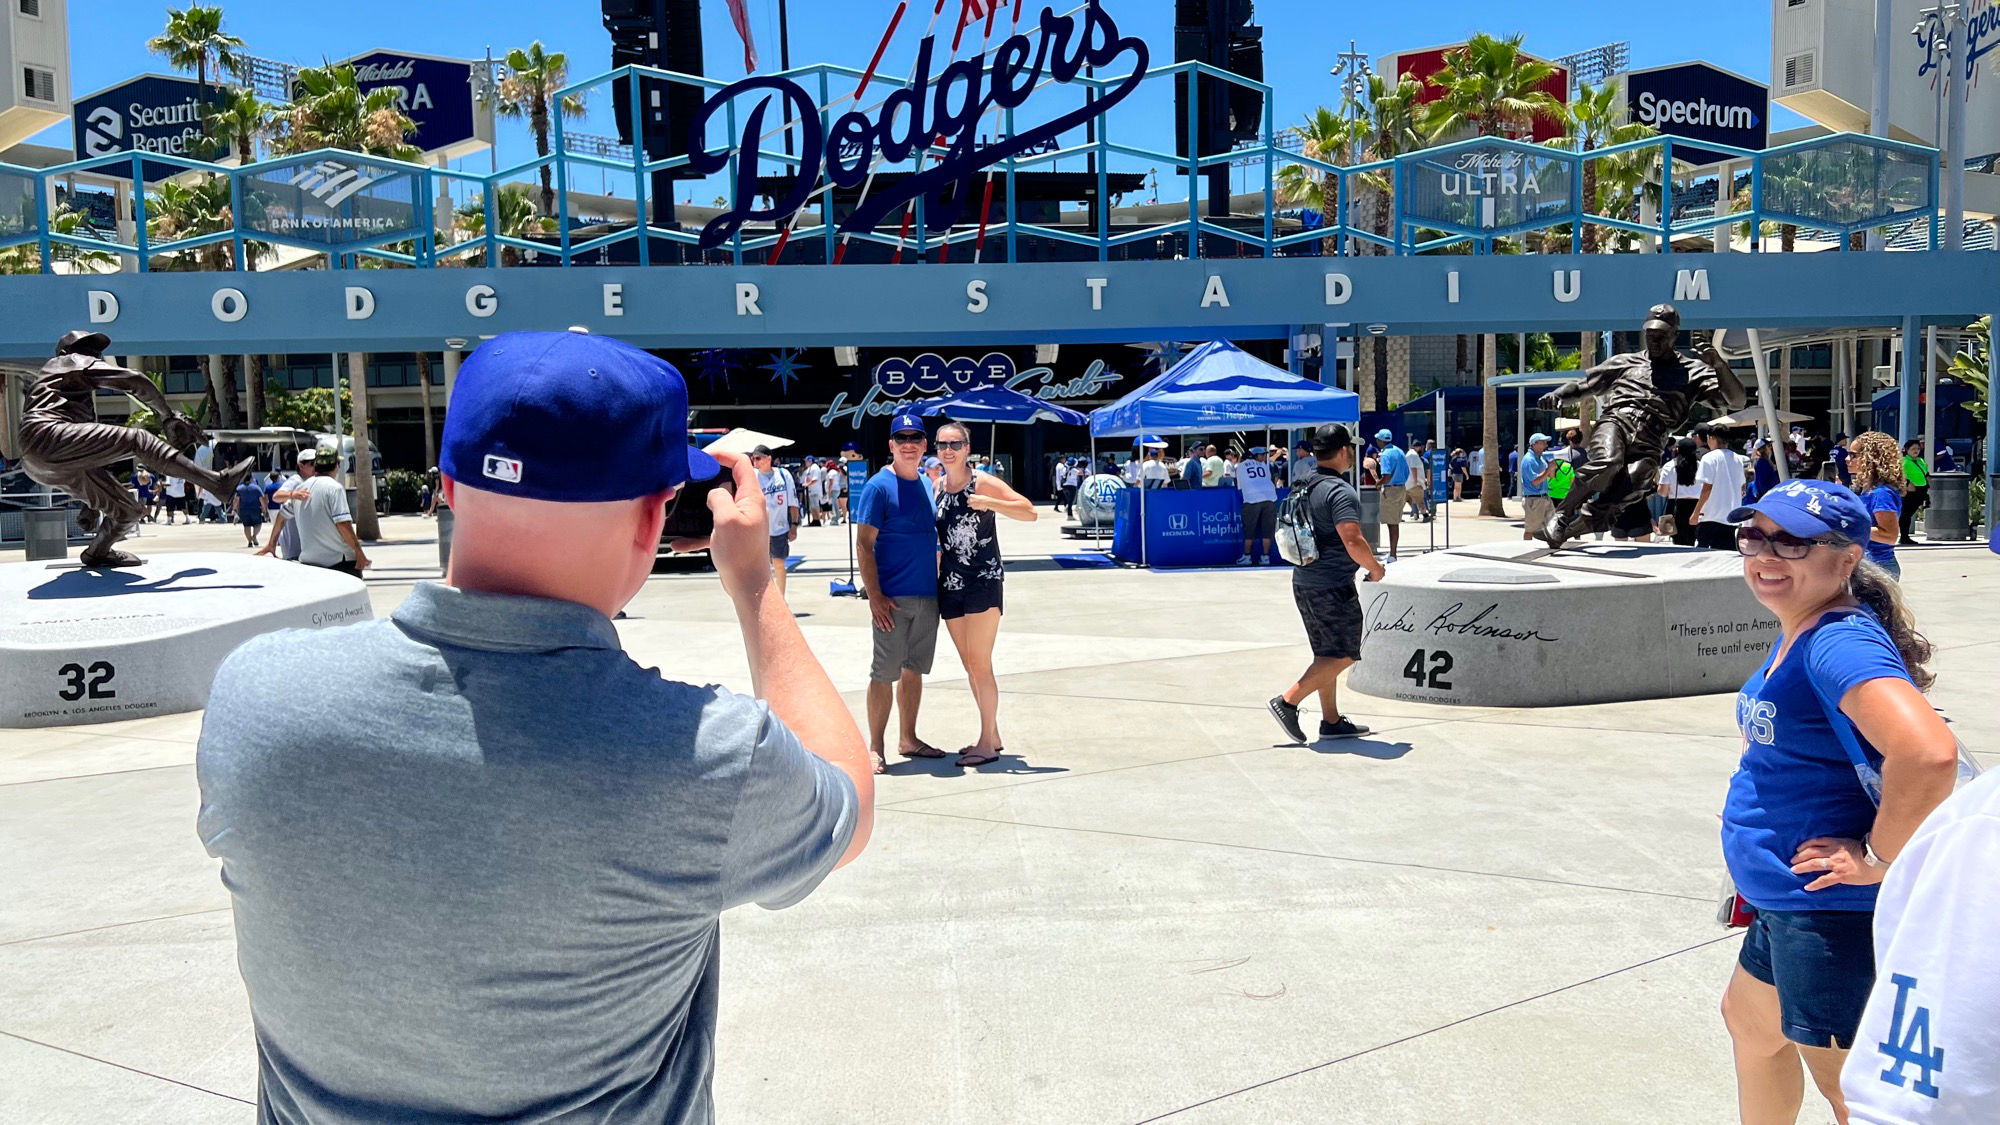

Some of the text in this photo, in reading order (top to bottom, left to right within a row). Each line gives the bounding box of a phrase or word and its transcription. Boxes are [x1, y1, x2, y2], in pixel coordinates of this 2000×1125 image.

[352, 60, 415, 82] Michelob
[129, 97, 213, 128] Securit
[1638, 91, 1752, 129] Spectrum
[688, 0, 1149, 249] Dodgers
[1441, 172, 1541, 195] ULTRA
[272, 217, 394, 229] BANK OF AMERICA
[88, 268, 1710, 323] DODGER STADIUM
[886, 364, 1006, 385] BLUE
[1275, 402, 1304, 411] Dealers
[902, 415, 913, 426] LA
[1246, 466, 1266, 479] 50
[777, 494, 784, 505] 5
[1806, 494, 1822, 515] LA
[1202, 511, 1231, 522] SoCal
[1202, 523, 1240, 537] Helpful
[312, 613, 322, 627] Cy
[322, 610, 345, 622] Young
[1360, 591, 1559, 653] Jackie Robinson
[1717, 621, 1733, 633] not
[1735, 622, 1749, 632] an
[1752, 618, 1782, 631] Ameri
[1697, 640, 1772, 657] free until every
[1403, 648, 1454, 690] 42
[58, 661, 116, 702] 32
[88, 705, 121, 713] ANGELES
[124, 702, 157, 710] DODGERS
[1878, 972, 1944, 1099] LA
